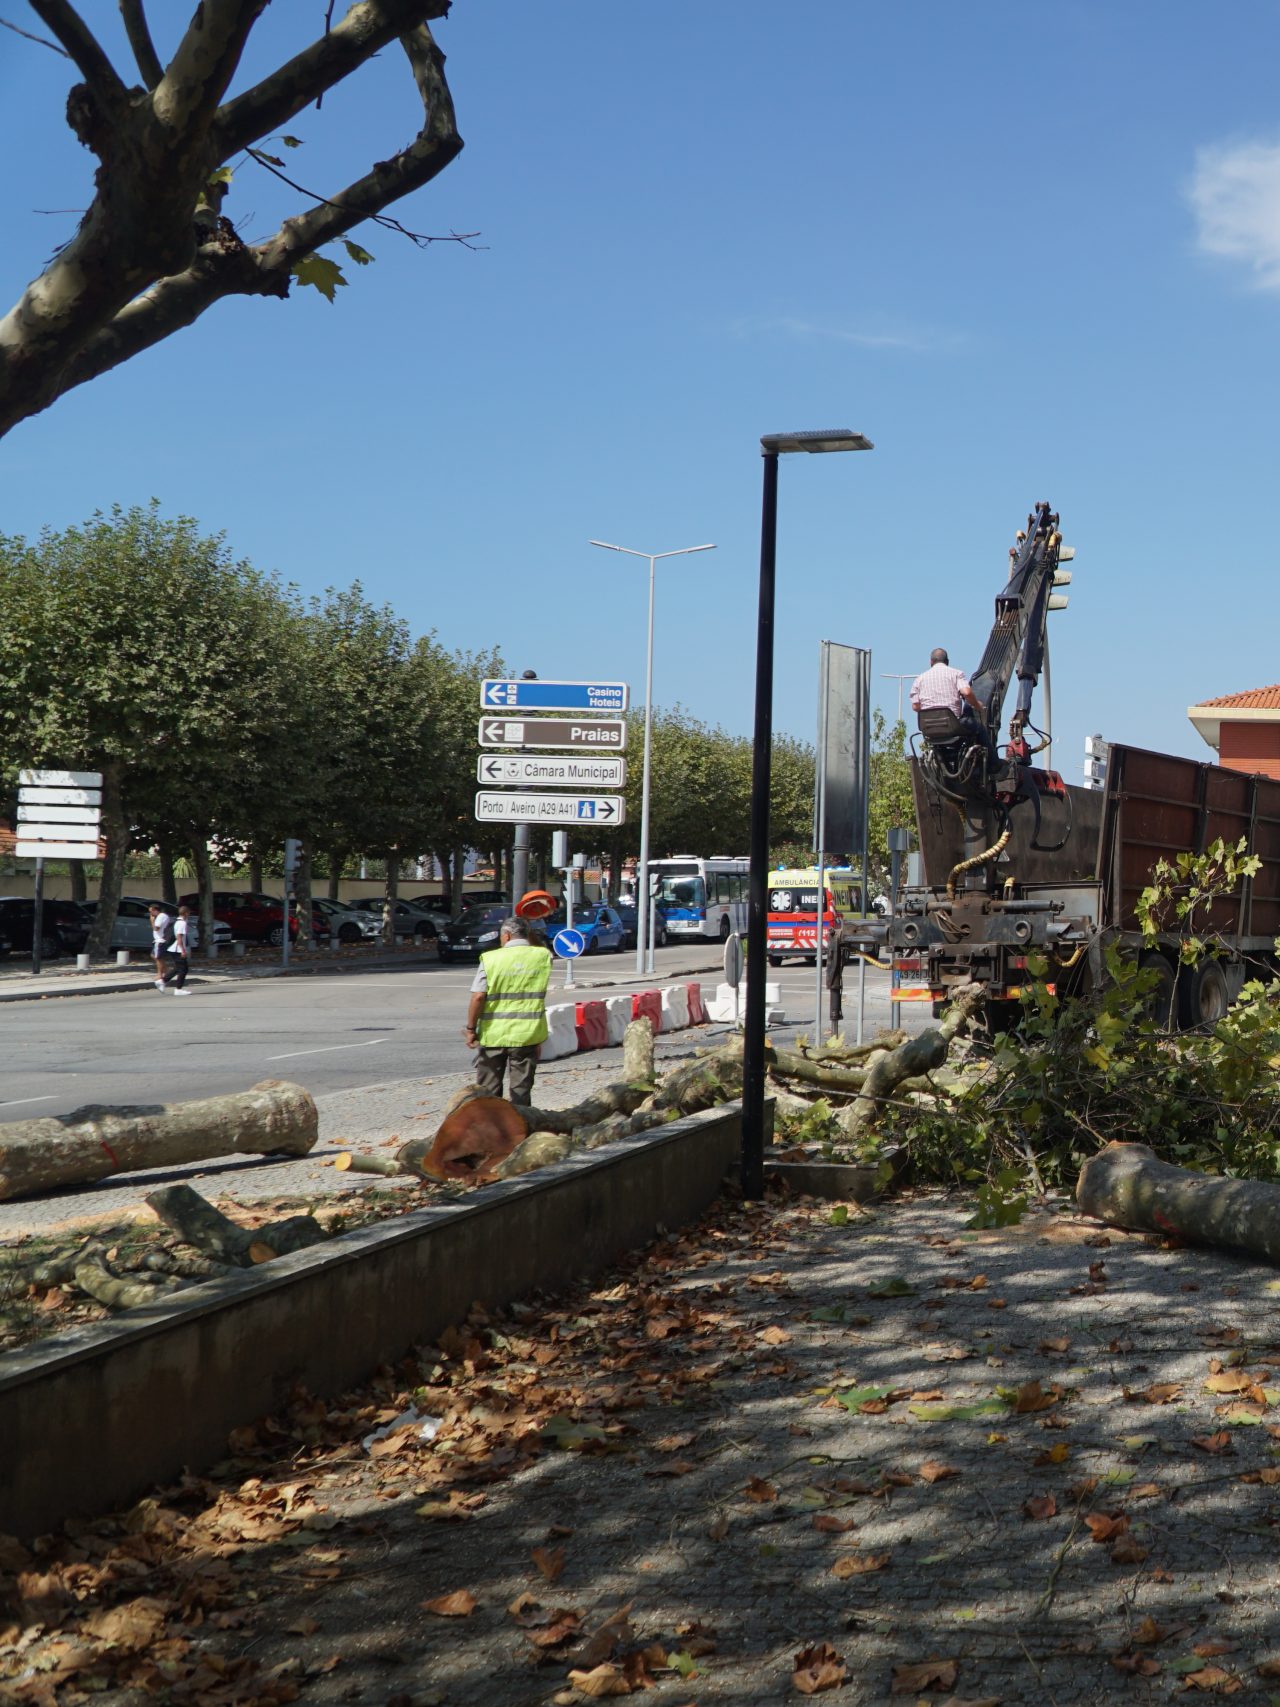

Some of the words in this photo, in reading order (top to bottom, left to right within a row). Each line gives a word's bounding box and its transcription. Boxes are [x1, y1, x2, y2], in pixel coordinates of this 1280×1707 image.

[587, 686, 622, 697] Casino
[589, 697, 621, 708] Hoteis
[570, 727, 620, 742] Praias
[524, 763, 565, 778] Câmara
[567, 765, 618, 782] Municipal
[482, 800, 504, 814] Porto
[510, 801, 536, 815] Aveiro
[801, 895, 825, 904] INE
[802, 929, 816, 937] 112
